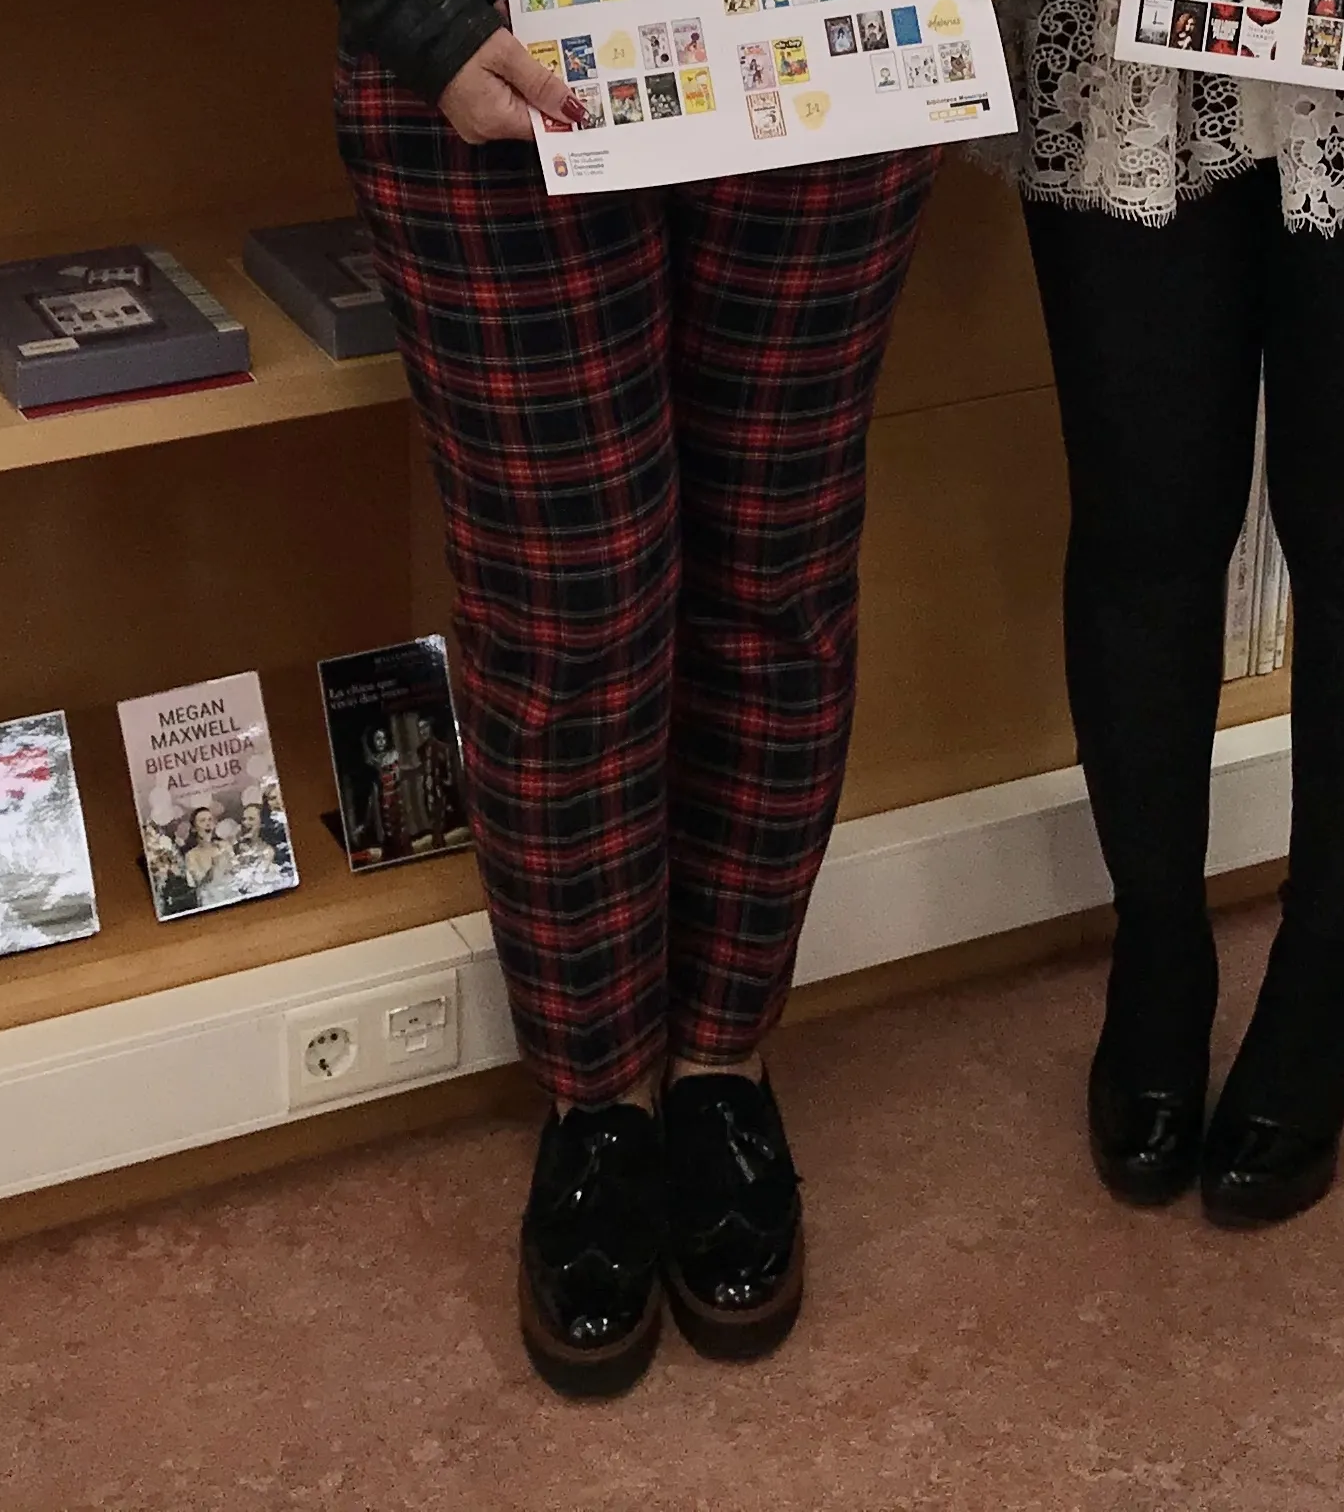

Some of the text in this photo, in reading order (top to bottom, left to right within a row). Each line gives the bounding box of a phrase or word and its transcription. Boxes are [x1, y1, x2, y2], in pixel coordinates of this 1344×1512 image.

[158, 698, 225, 728] MEGAN
[150, 716, 241, 750] MAXWELL
[145, 735, 256, 775] BIENVENIDA
[167, 774, 190, 791] AL
[193, 759, 242, 784] CLUB
